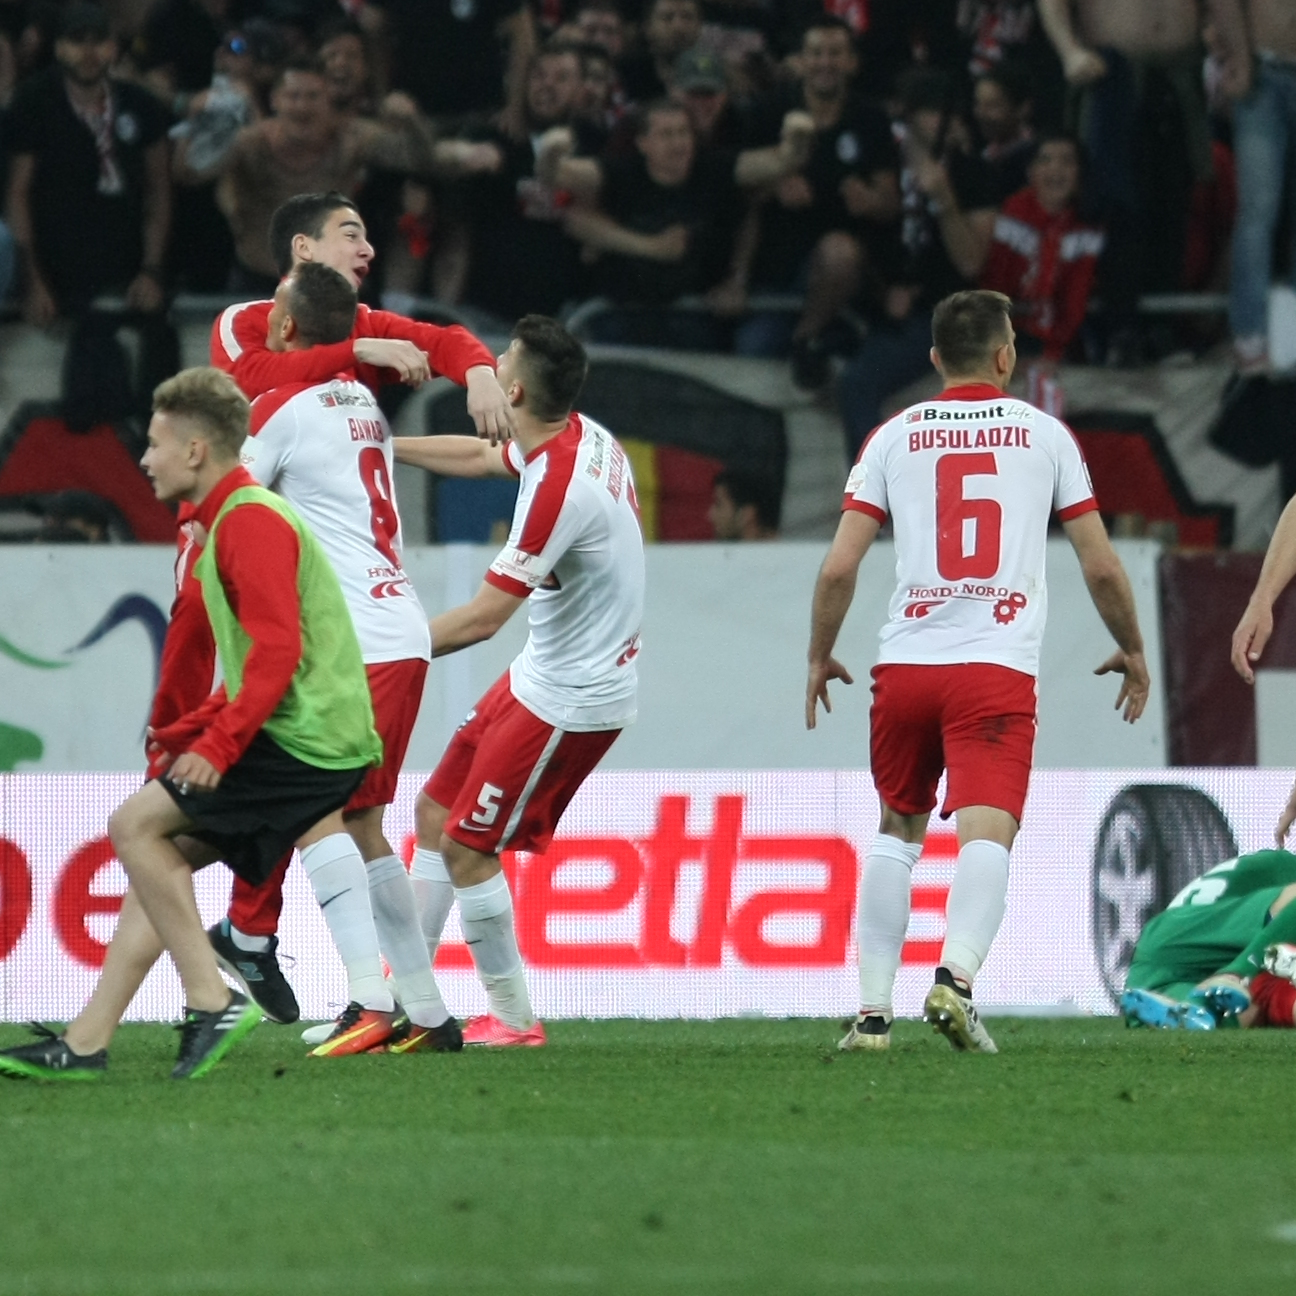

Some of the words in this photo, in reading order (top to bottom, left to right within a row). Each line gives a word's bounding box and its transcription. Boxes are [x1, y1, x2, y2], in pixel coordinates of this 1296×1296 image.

[923, 405, 1005, 421] Baumit
[908, 426, 1032, 453] BUSULADZIC
[936, 452, 1003, 582] 6
[471, 781, 504, 826] 5
